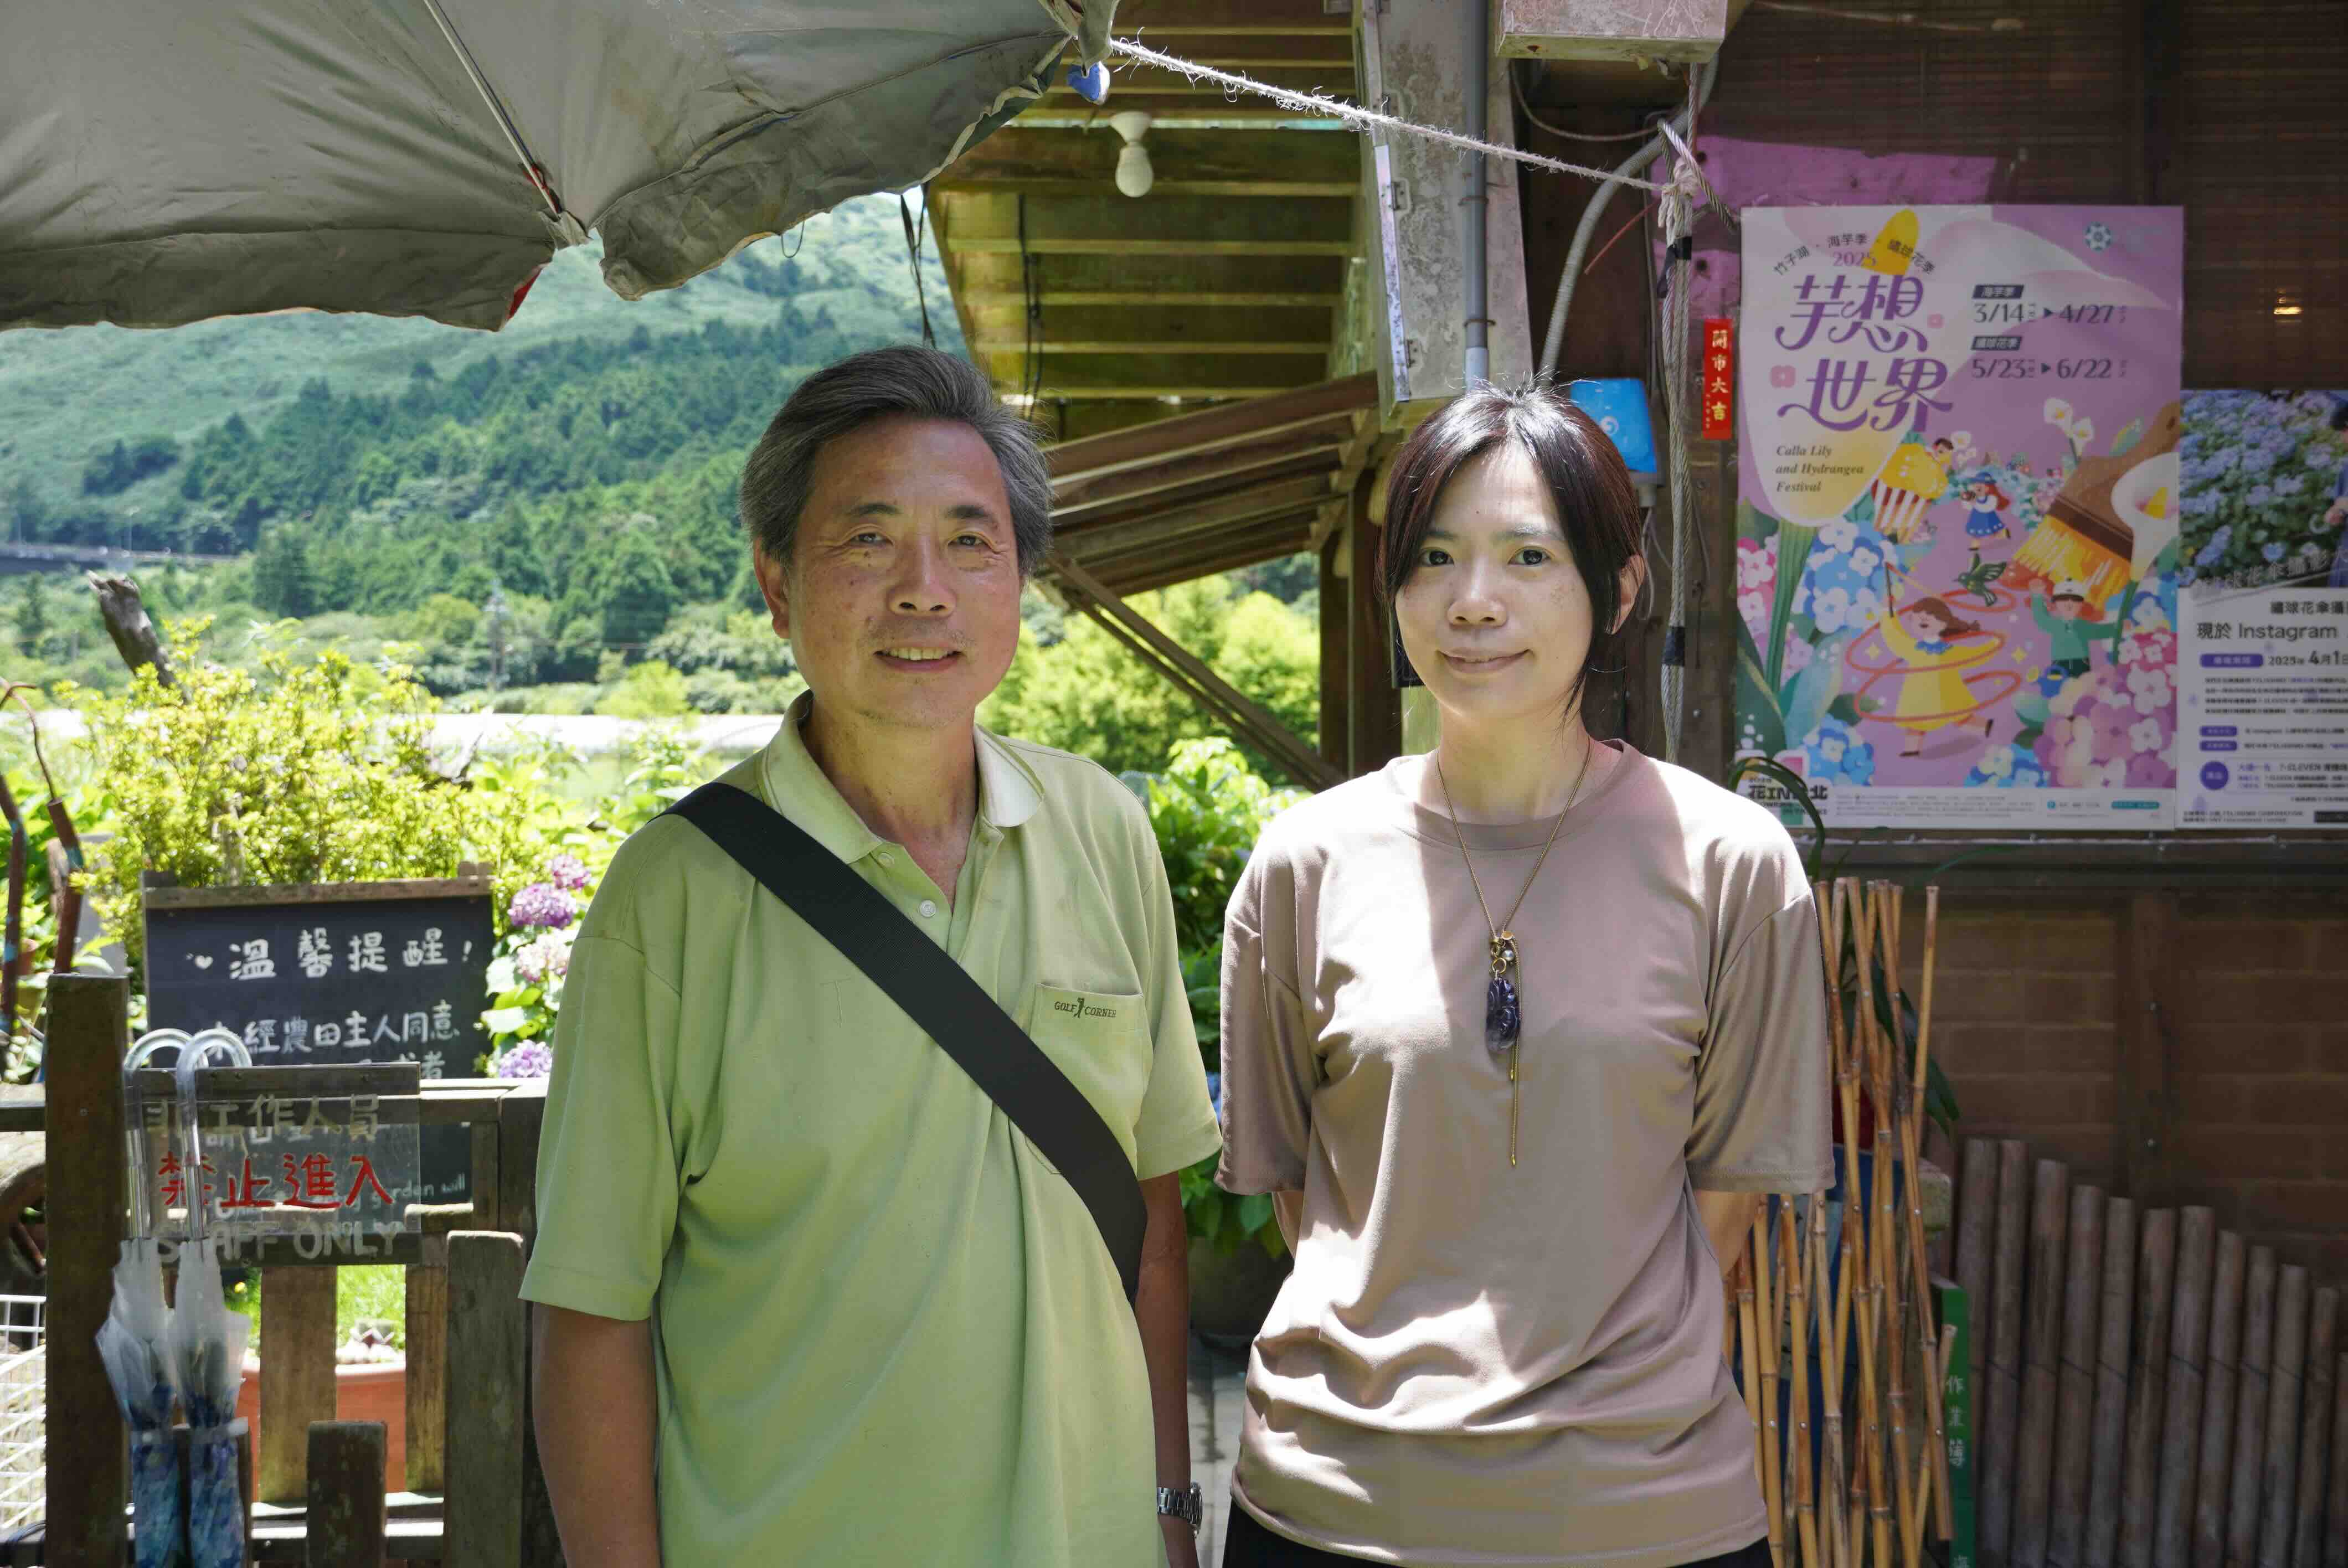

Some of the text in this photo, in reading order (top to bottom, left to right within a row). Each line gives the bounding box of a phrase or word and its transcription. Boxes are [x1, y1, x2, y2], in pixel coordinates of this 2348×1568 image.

[1774, 246, 1810, 275] 竹子湖
[1828, 233, 1867, 249] 海芋季
[1832, 251, 1876, 267] 2025
[1973, 303, 2024, 323] 3/14
[2059, 305, 2114, 324] 4/27
[1710, 329, 1729, 421] 開市大吉
[1972, 359, 2026, 379] 5/23
[2057, 359, 2112, 379] 6/22
[1777, 358, 1953, 432] 世界
[1776, 445, 1832, 459] Calla Lily
[1775, 463, 1864, 477] and Hydrangea
[1776, 481, 1821, 492] Festival
[2197, 622, 2337, 642] 現於 Instagram
[1054, 1001, 1117, 1018] GOLF CORNER
[158, 1152, 394, 1209] 禁止進入
[441, 1174, 466, 1194] will
[292, 1220, 400, 1260] ONLY
